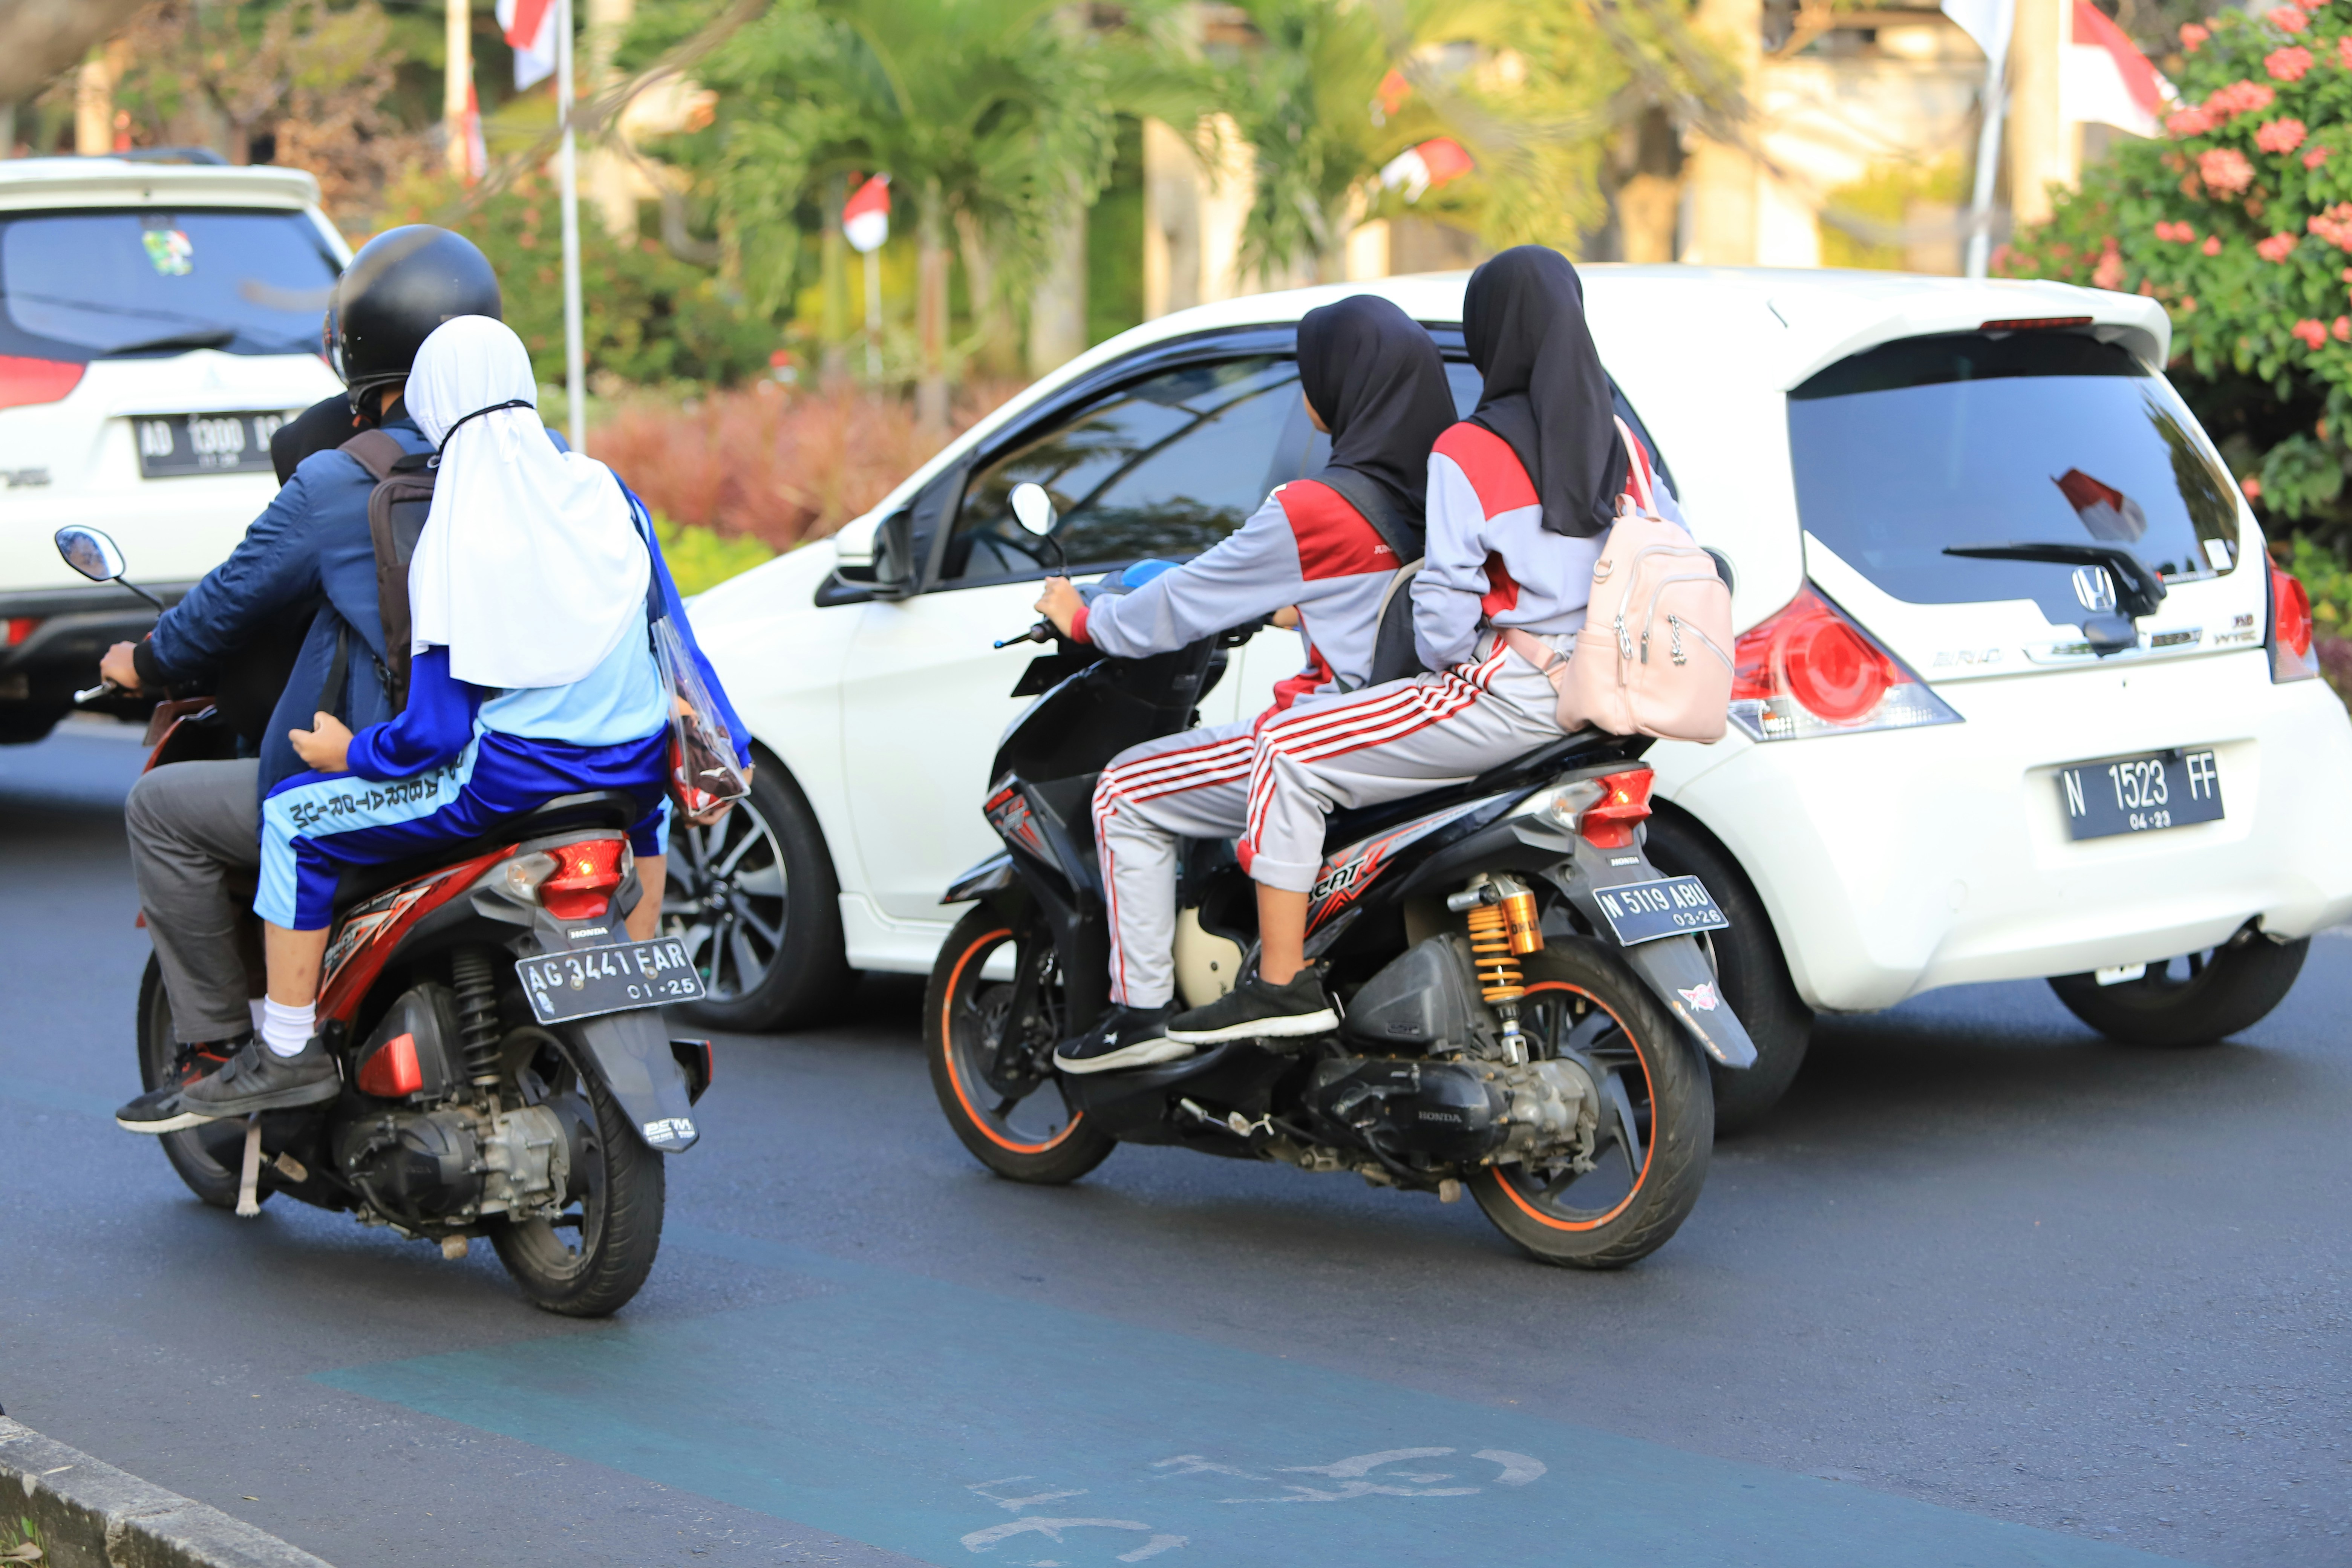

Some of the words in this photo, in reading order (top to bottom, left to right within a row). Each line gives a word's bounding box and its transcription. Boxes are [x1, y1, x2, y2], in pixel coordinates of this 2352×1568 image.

[2064, 769, 2086, 818] N
[2109, 759, 2169, 811] 1523
[2185, 751, 2217, 801] FF
[1611, 856, 1639, 867] HONDA
[1601, 894, 1624, 918] N
[1620, 888, 1670, 914] 5119
[1668, 883, 1709, 909] ABU
[570, 926, 608, 939] HONDA
[528, 961, 564, 992] AG
[565, 950, 631, 981] 3441
[1418, 1111, 1462, 1123] HONDA
